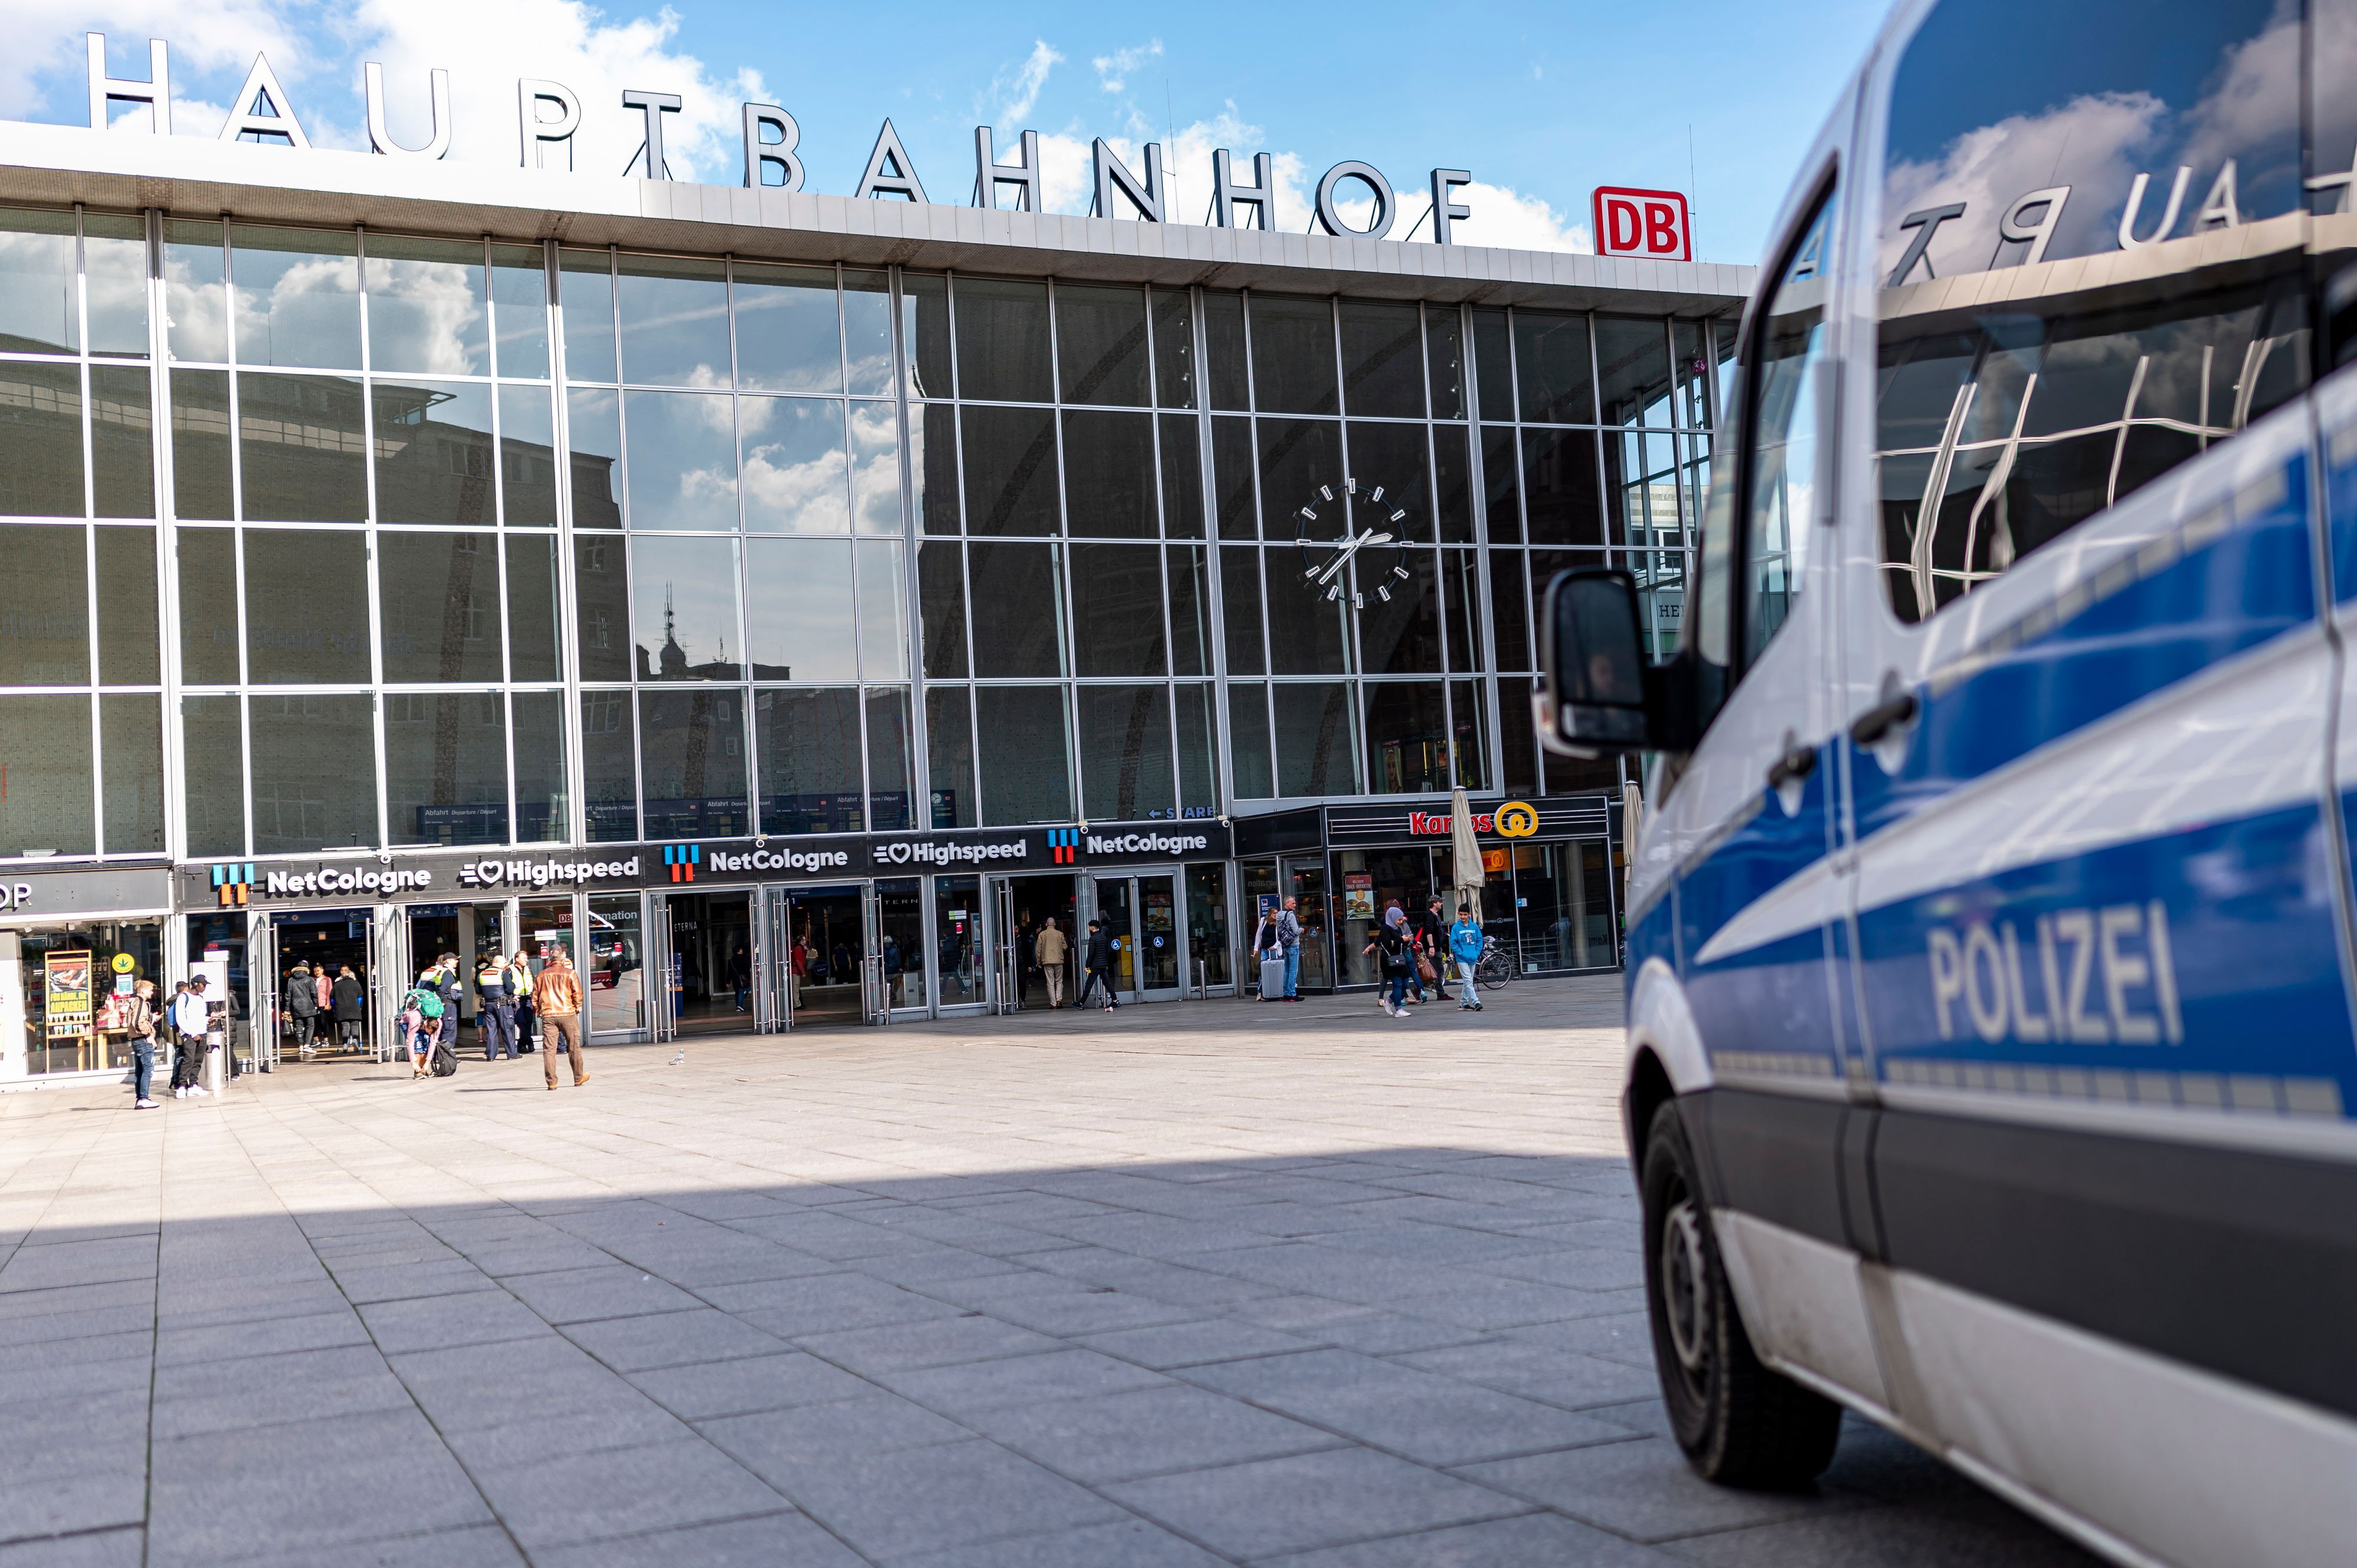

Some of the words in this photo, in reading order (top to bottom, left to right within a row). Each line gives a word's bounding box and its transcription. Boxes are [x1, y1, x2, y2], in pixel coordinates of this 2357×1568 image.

[87, 32, 1471, 245] HAUPTBAHNHOF
[1607, 199, 1678, 253] DB
[912, 839, 1026, 866] Highspeed
[1087, 832, 1207, 854] NetCologne
[507, 856, 639, 885] Highspeed
[710, 848, 848, 872] NetCologne
[268, 867, 431, 893] NetCologne
[674, 921, 697, 932] ETERNA
[1926, 897, 2184, 1045] POLIZEI
